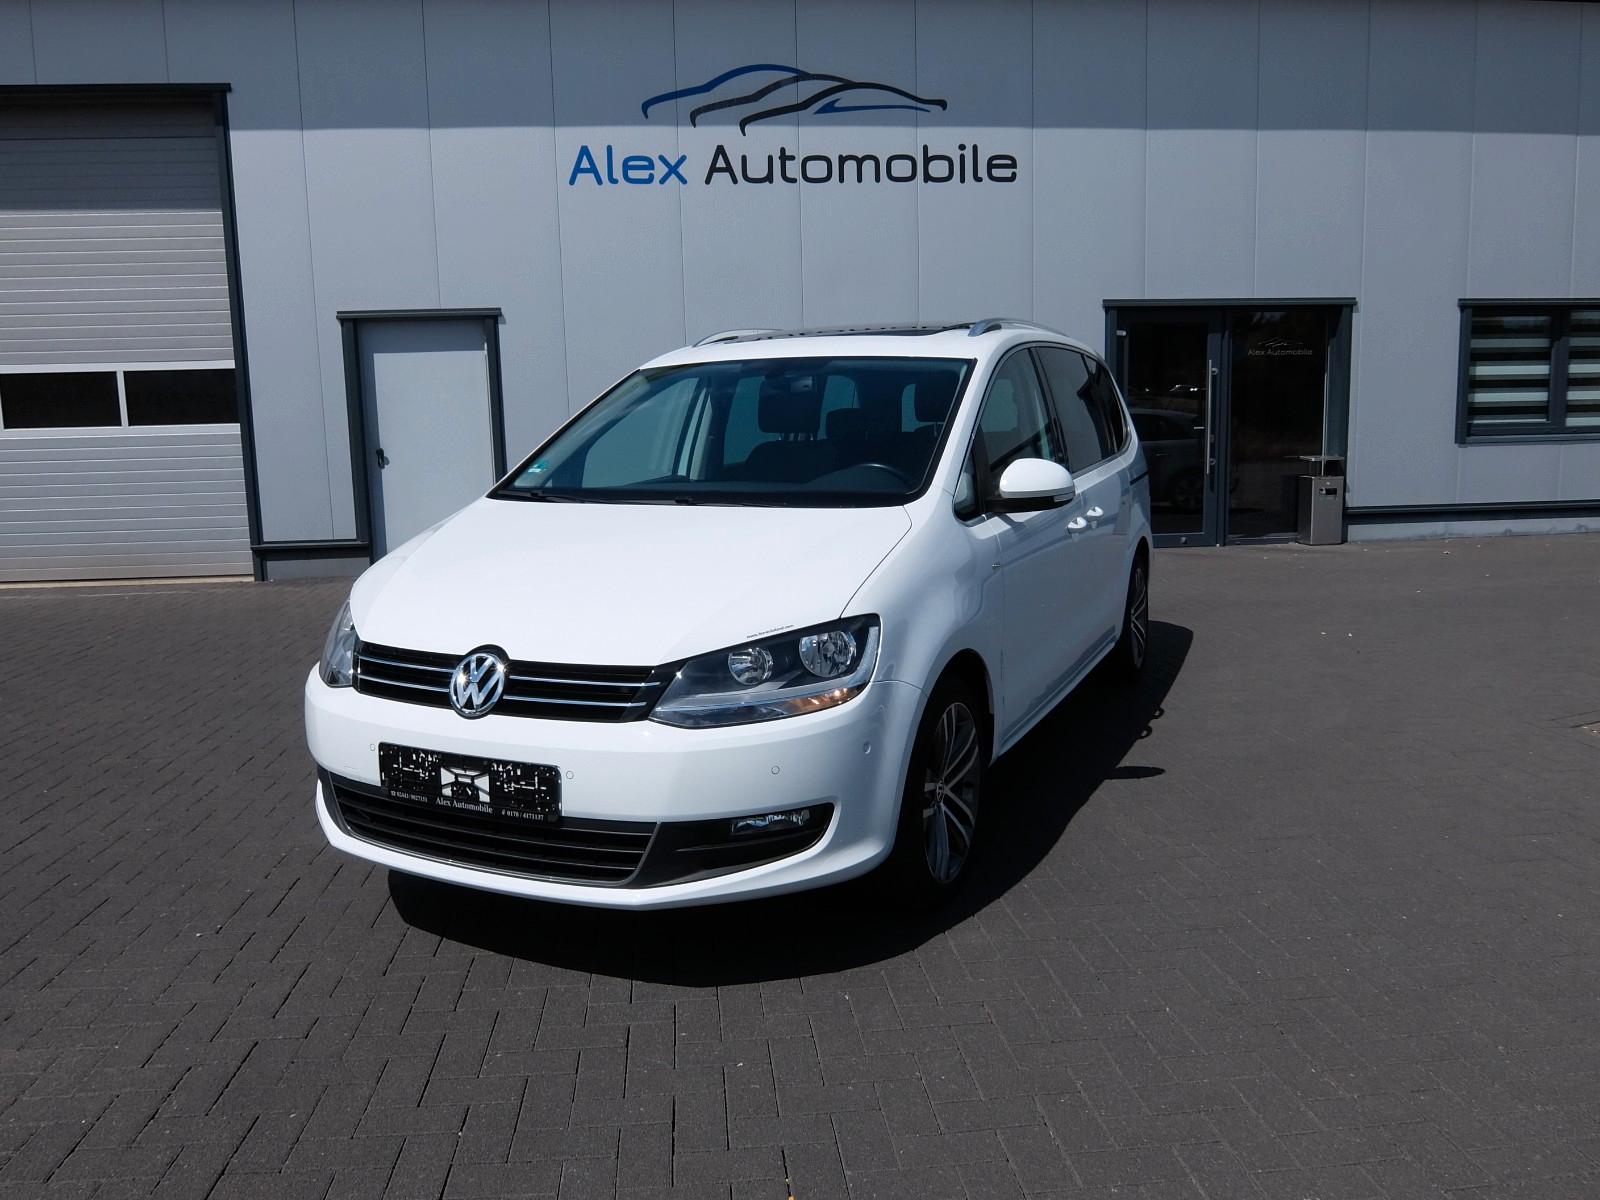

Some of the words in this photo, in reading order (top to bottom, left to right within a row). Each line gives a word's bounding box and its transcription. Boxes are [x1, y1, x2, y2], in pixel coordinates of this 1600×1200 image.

[568, 144, 688, 186] Alex
[704, 143, 1018, 185] Automobile
[1247, 348, 1265, 356] Alex
[1266, 348, 1313, 356] Automobile
[435, 796, 452, 807] Alex
[452, 799, 494, 814] Automobile
